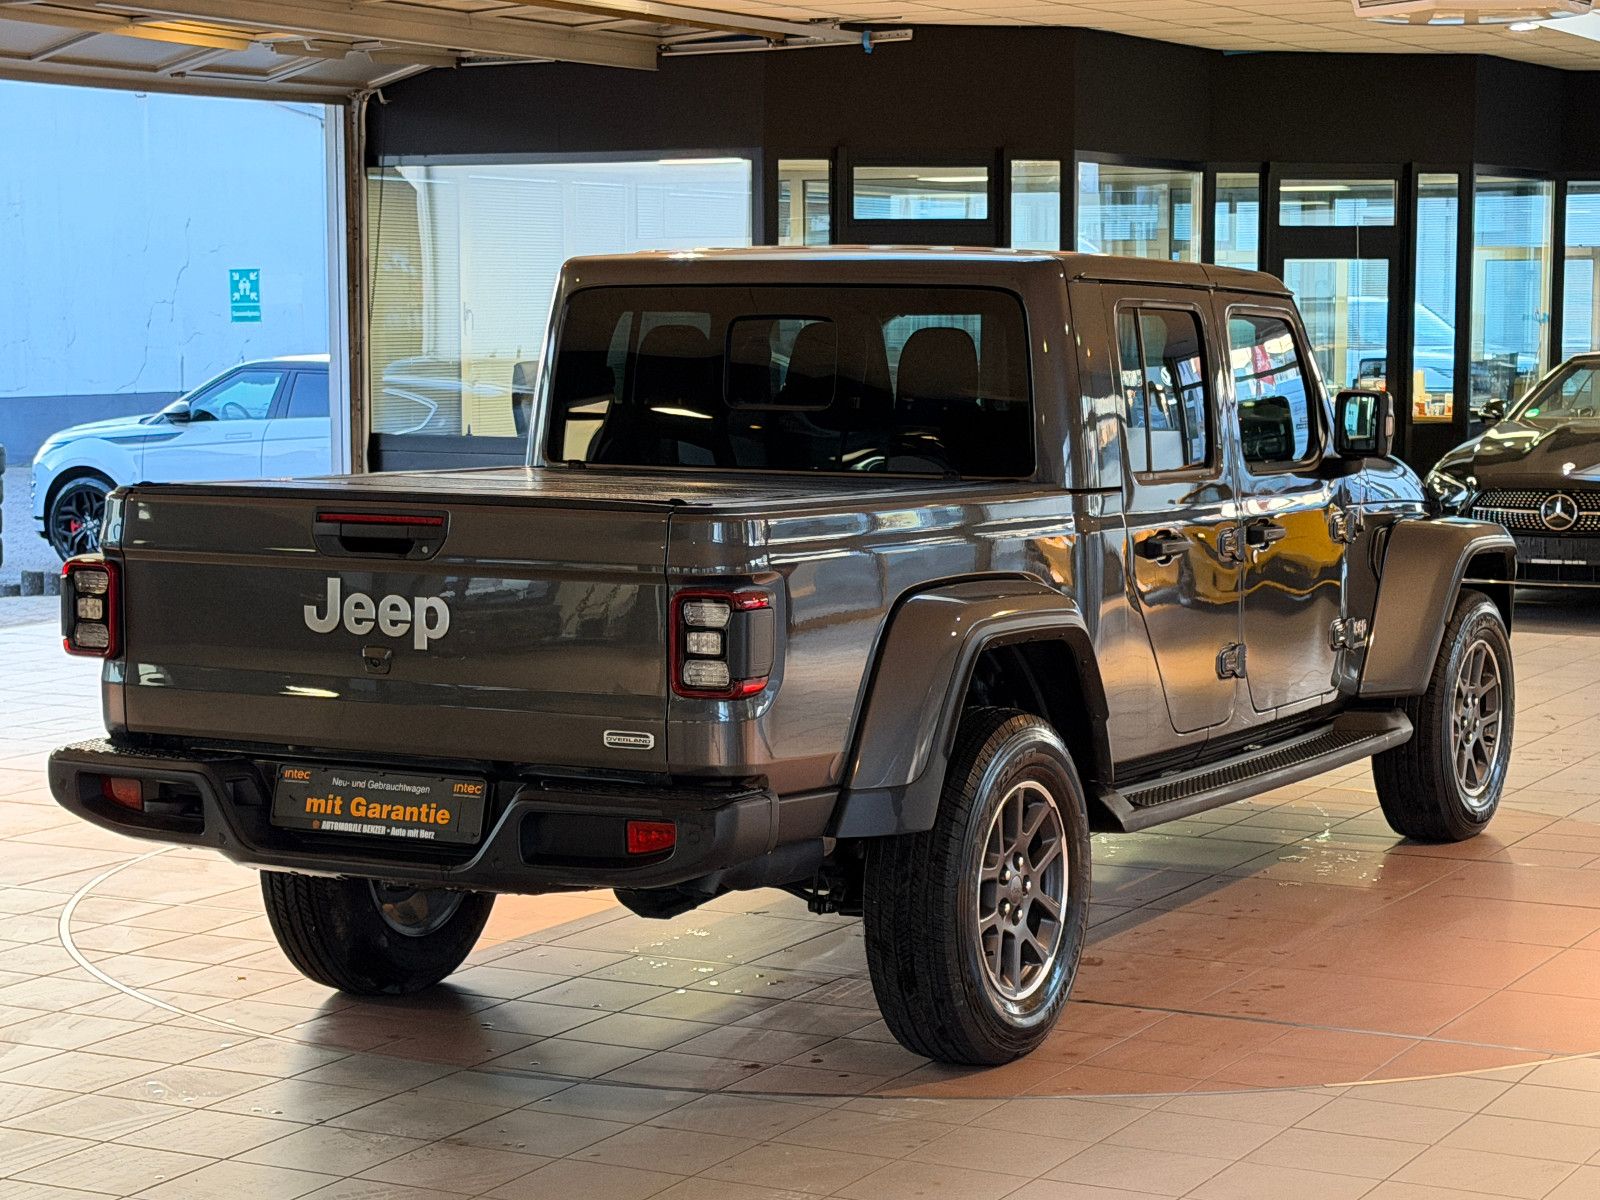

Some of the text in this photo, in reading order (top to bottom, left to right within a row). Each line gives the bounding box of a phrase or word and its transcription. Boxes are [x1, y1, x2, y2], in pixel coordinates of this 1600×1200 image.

[304, 577, 449, 650] Jeep
[606, 736, 651, 744] OVERLAND
[284, 769, 311, 780] intec
[332, 777, 430, 795] Neu- und Gebrauchtwagen
[453, 783, 483, 794] intec
[305, 794, 450, 825] mit Garantie
[321, 820, 362, 833] AUTOMOBILE
[390, 826, 407, 837] Auto
[407, 828, 419, 838] mit
[420, 830, 435, 840] Herz
